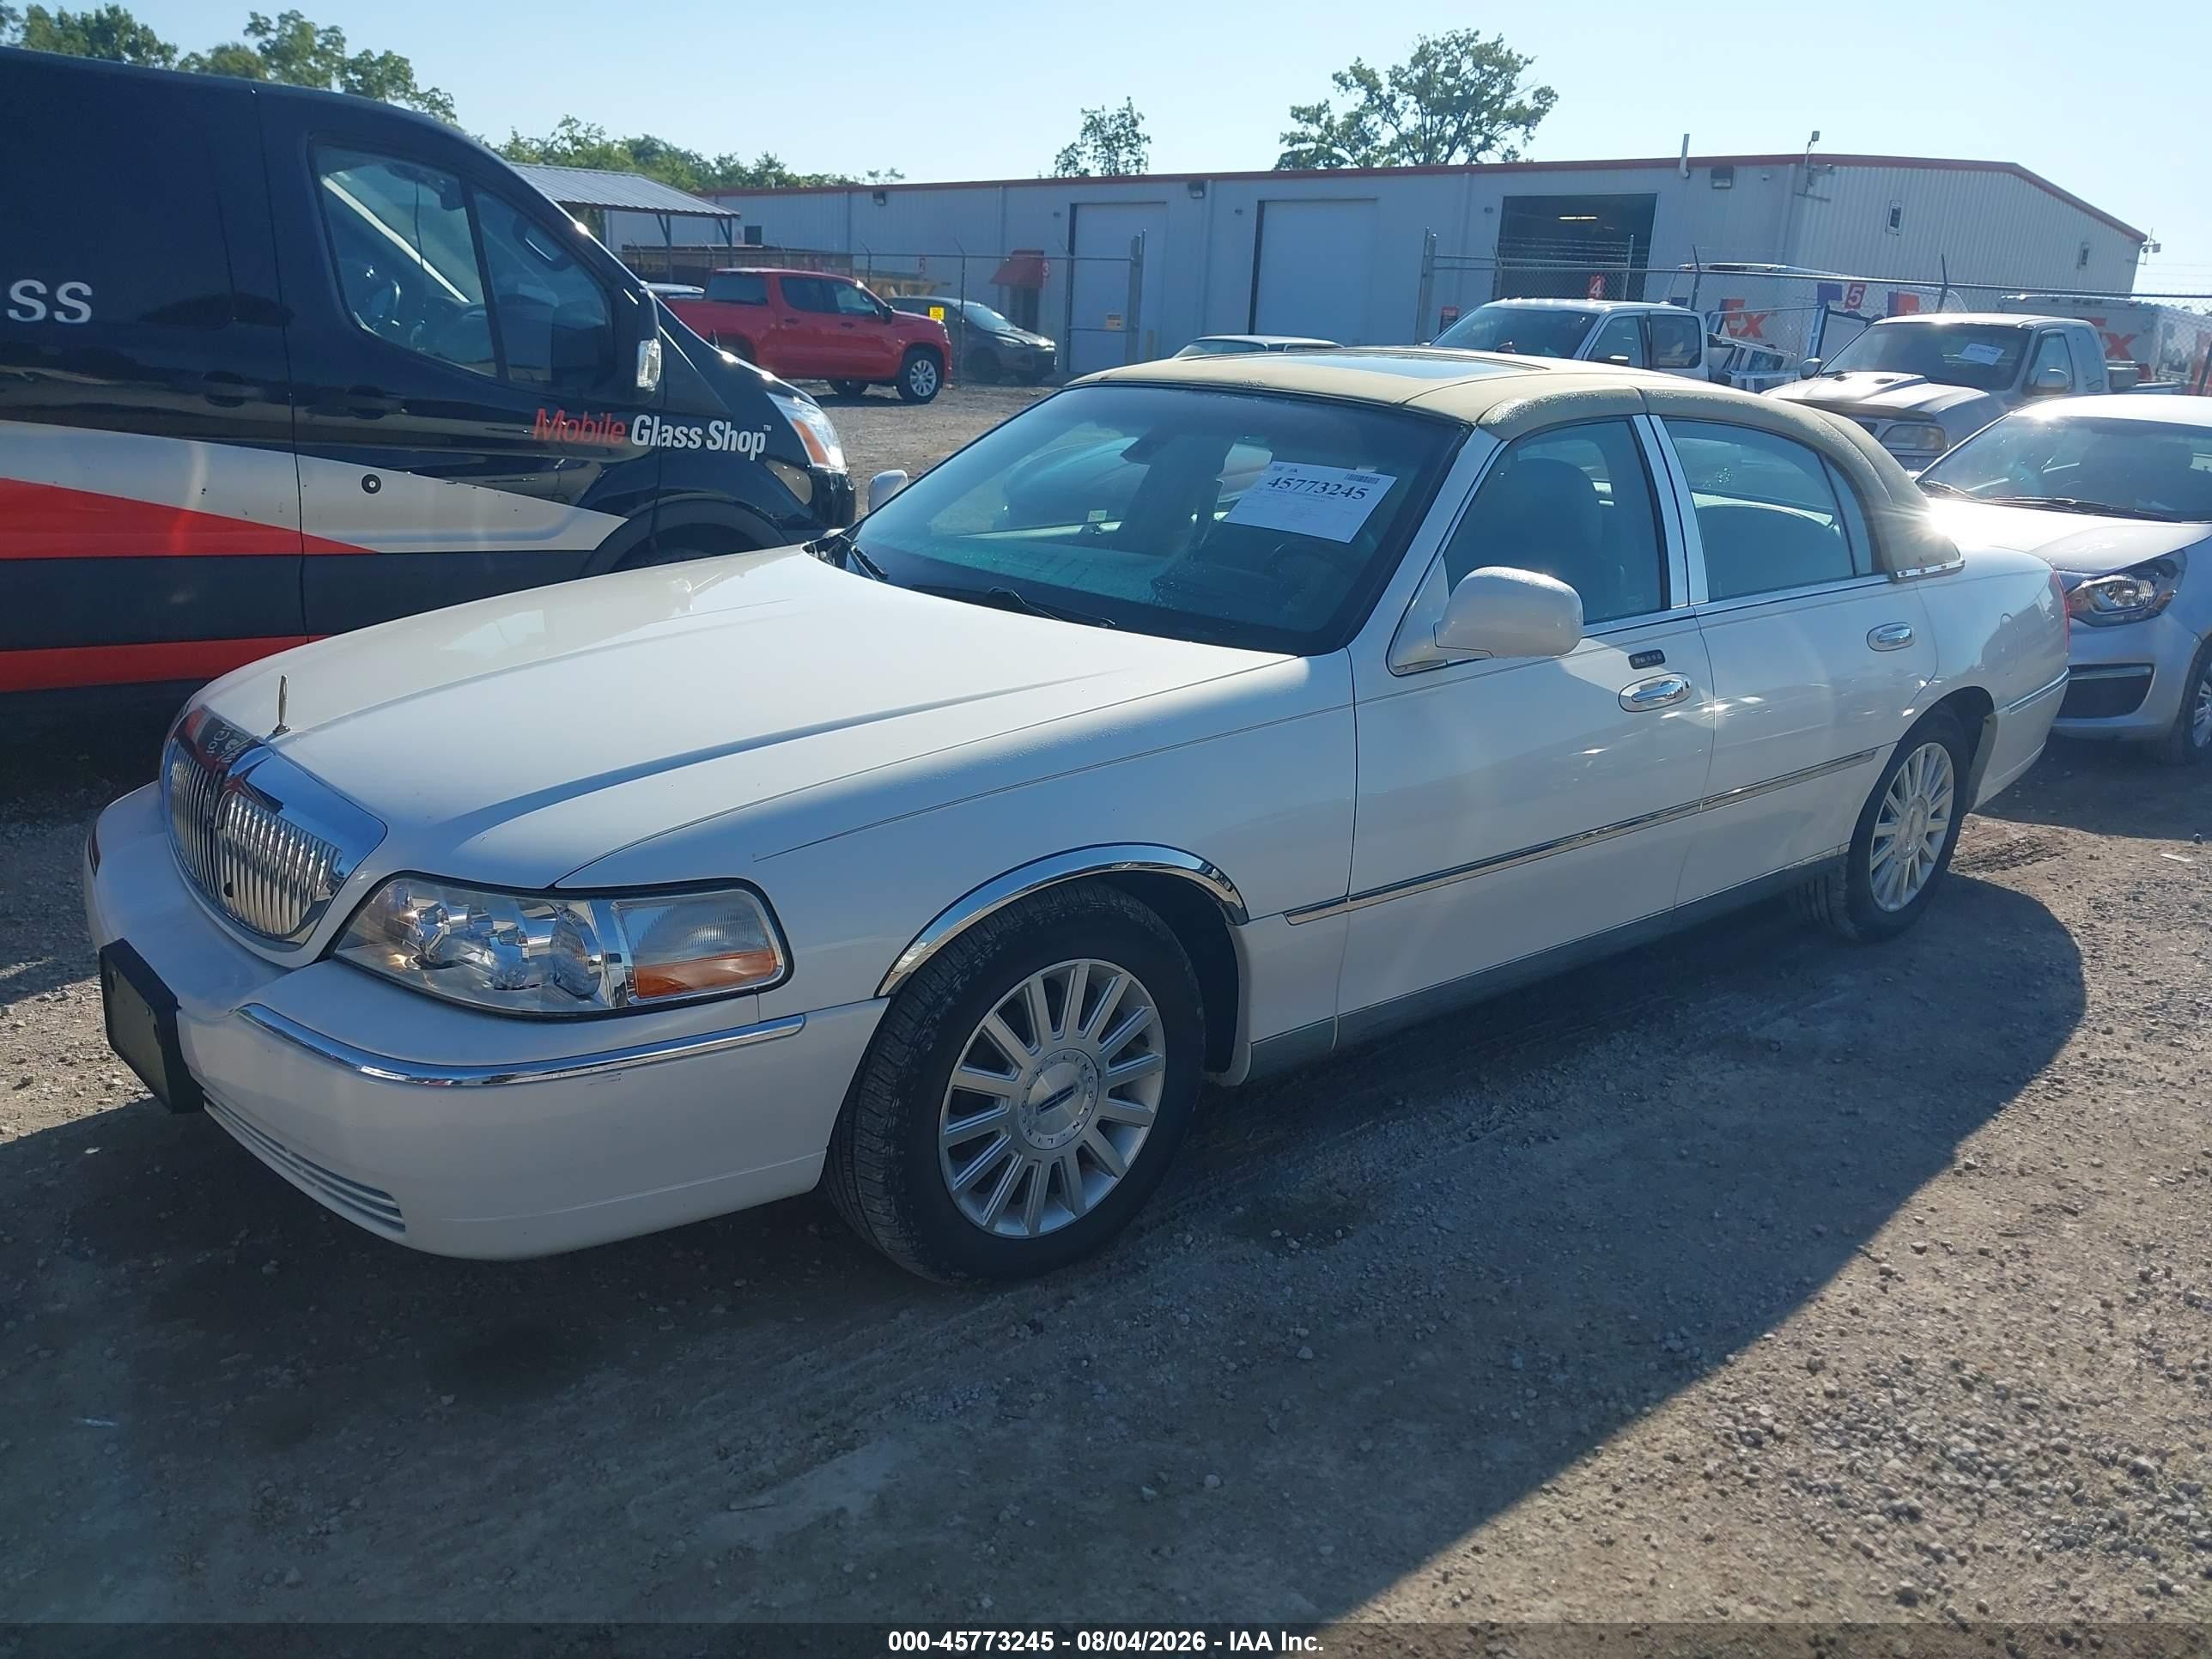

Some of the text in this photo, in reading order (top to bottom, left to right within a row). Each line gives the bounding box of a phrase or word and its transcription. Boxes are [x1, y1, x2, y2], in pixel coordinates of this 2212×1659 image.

[1847, 286, 1863, 307] 5
[533, 408, 626, 443] Mobile
[631, 415, 703, 449] Glass
[1267, 477, 1370, 500] 45773245
